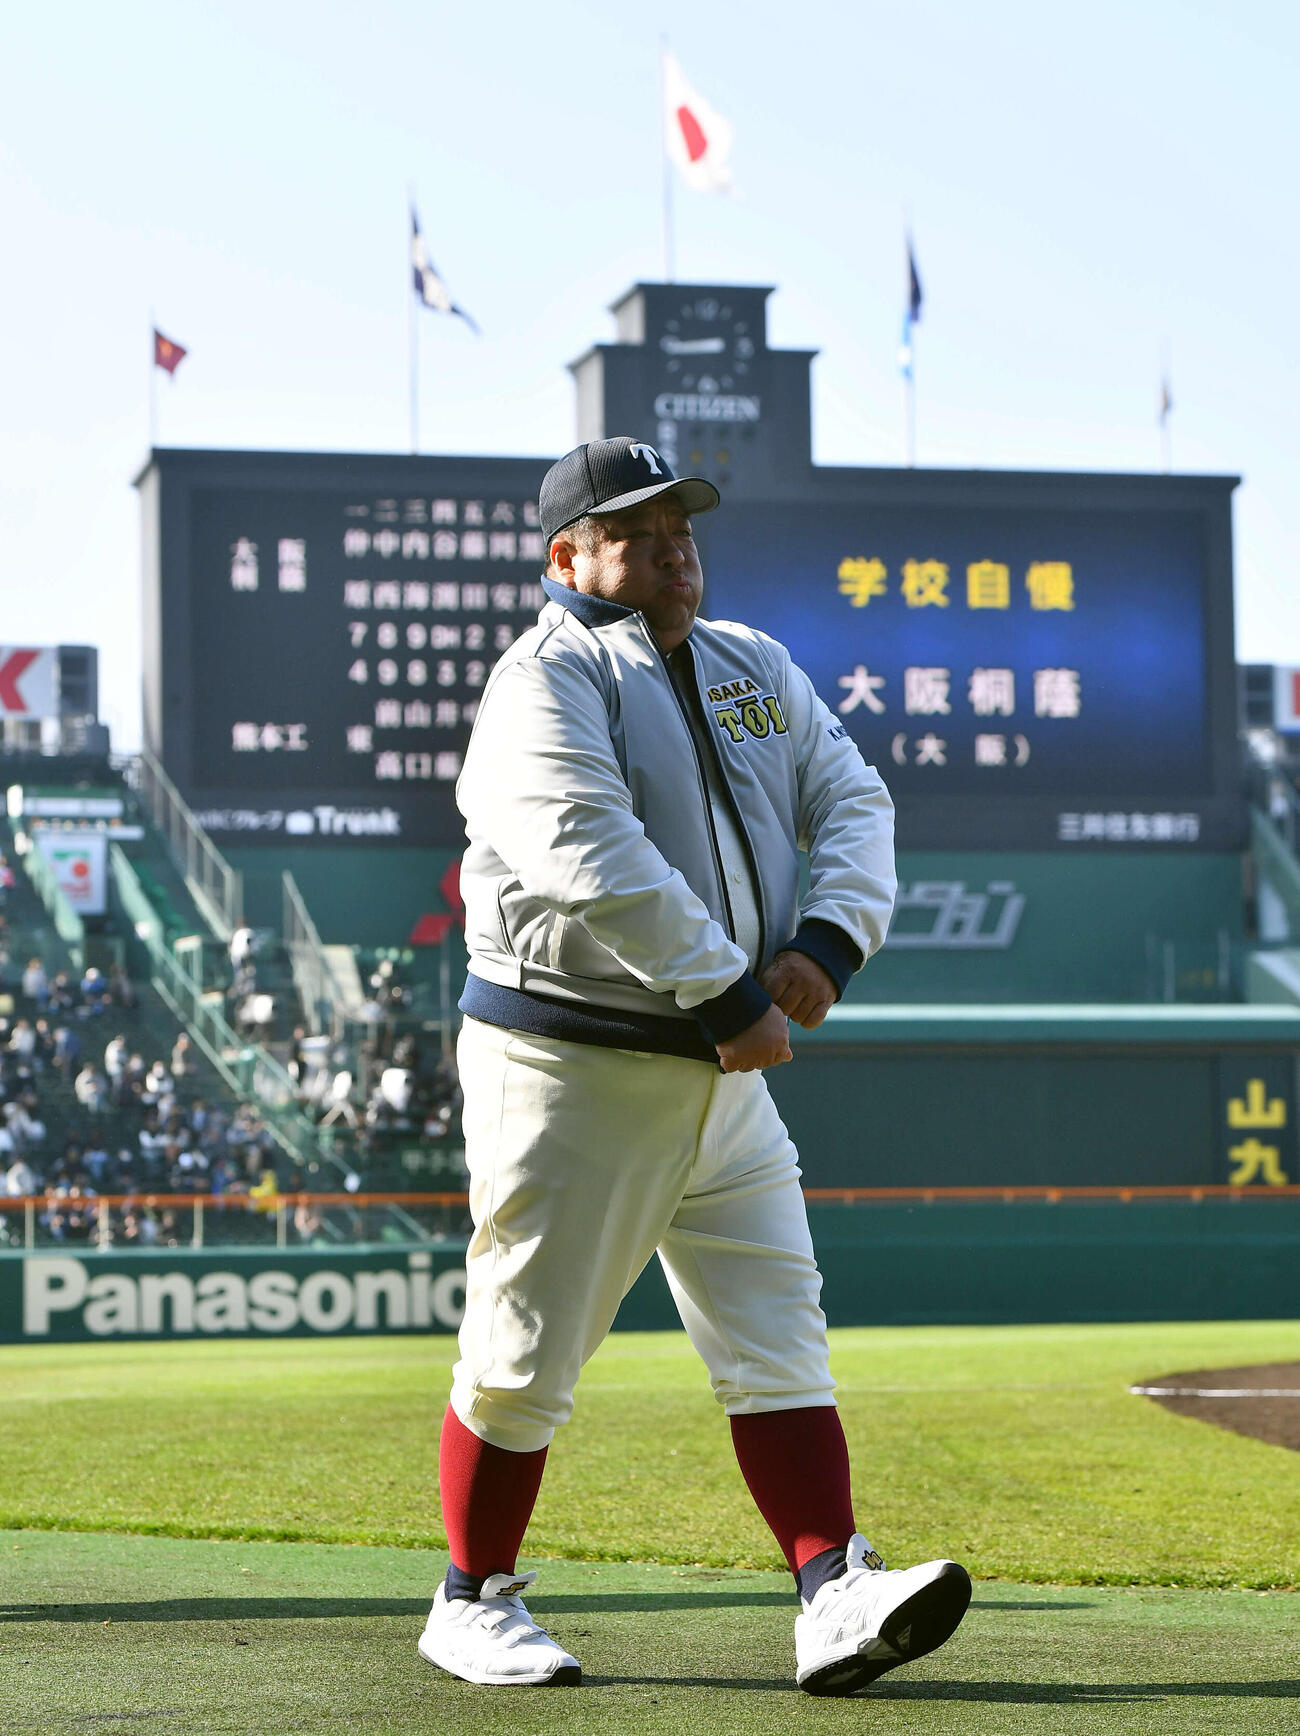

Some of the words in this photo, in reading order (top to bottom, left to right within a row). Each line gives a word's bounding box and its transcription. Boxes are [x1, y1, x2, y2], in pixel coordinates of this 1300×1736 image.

[654, 393, 761, 421] CITIZEN
[630, 442, 662, 476] T
[837, 556, 1075, 611] 学校自慢
[348, 622, 369, 648] 7
[465, 624, 485, 650] 2
[348, 658, 369, 685] 4
[465, 660, 486, 686] 2
[837, 664, 1081, 717] 大阪桐蔭
[316, 806, 400, 834] Trunk
[1227, 1078, 1288, 1187] 山九
